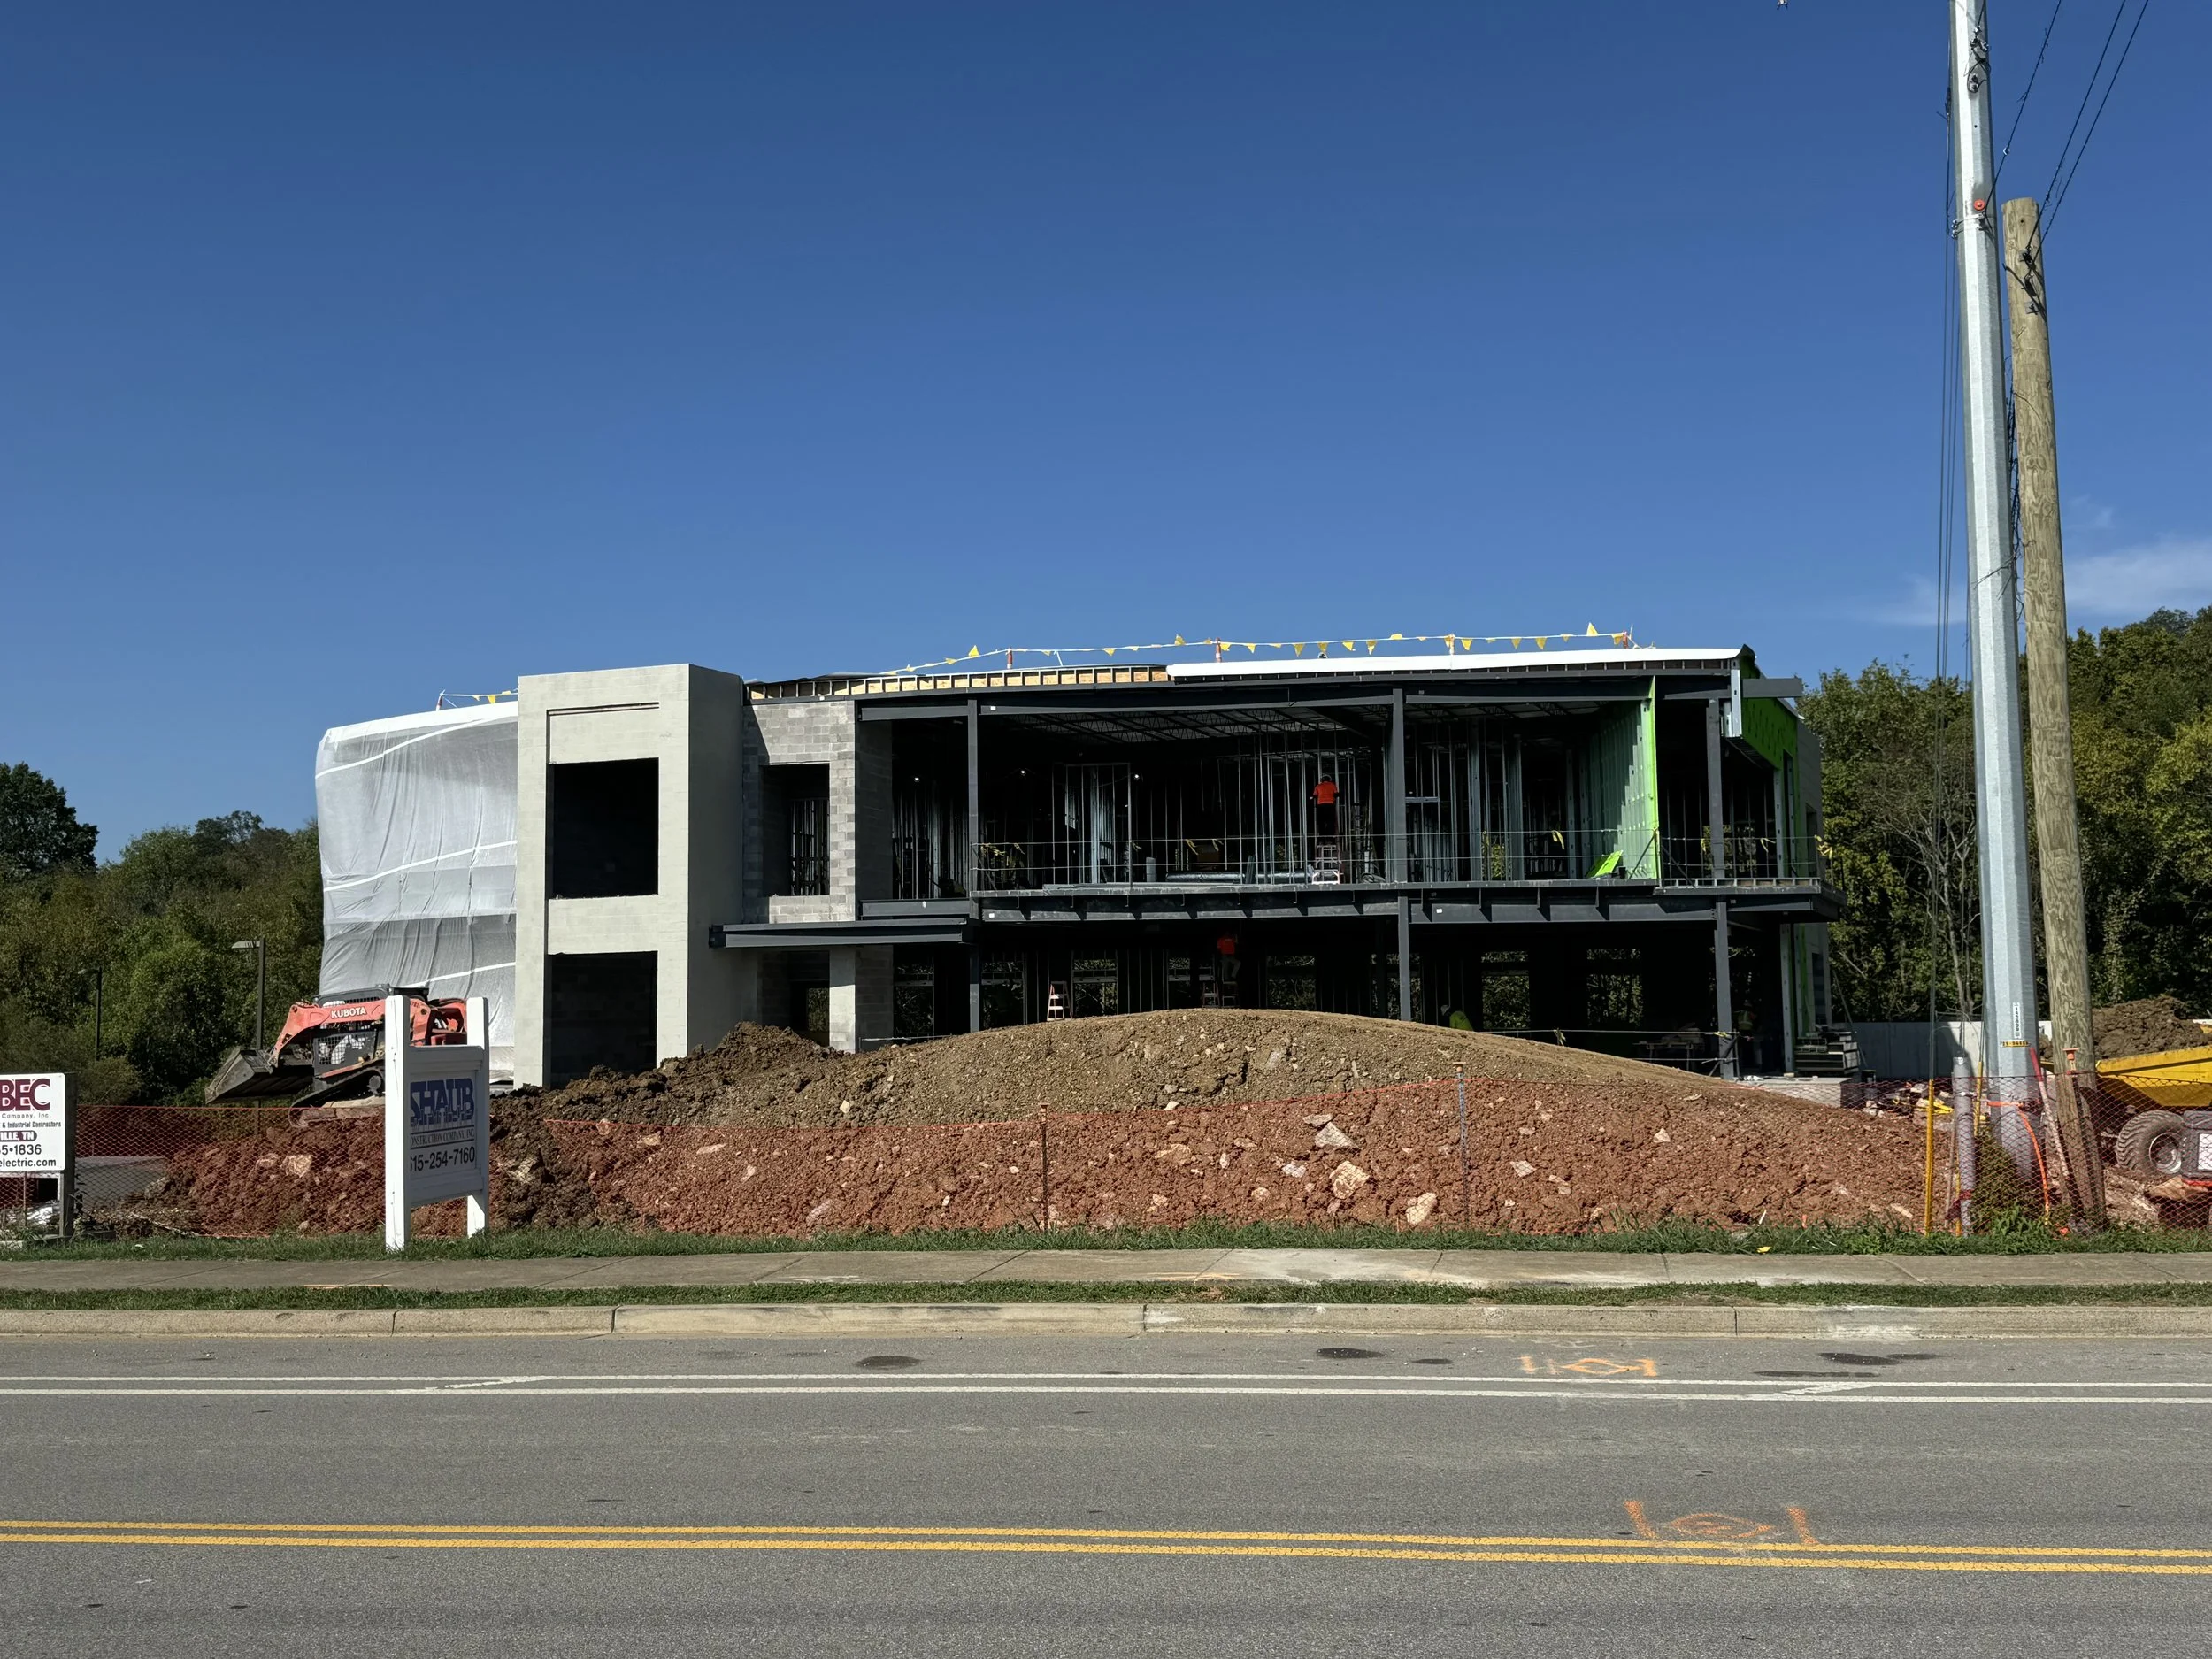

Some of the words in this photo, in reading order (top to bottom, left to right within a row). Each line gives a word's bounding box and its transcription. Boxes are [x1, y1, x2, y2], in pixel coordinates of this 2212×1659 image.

[331, 1007, 367, 1018] KUBOTA
[411, 1078, 474, 1127] SHAUB
[21, 1131, 34, 1141] TN
